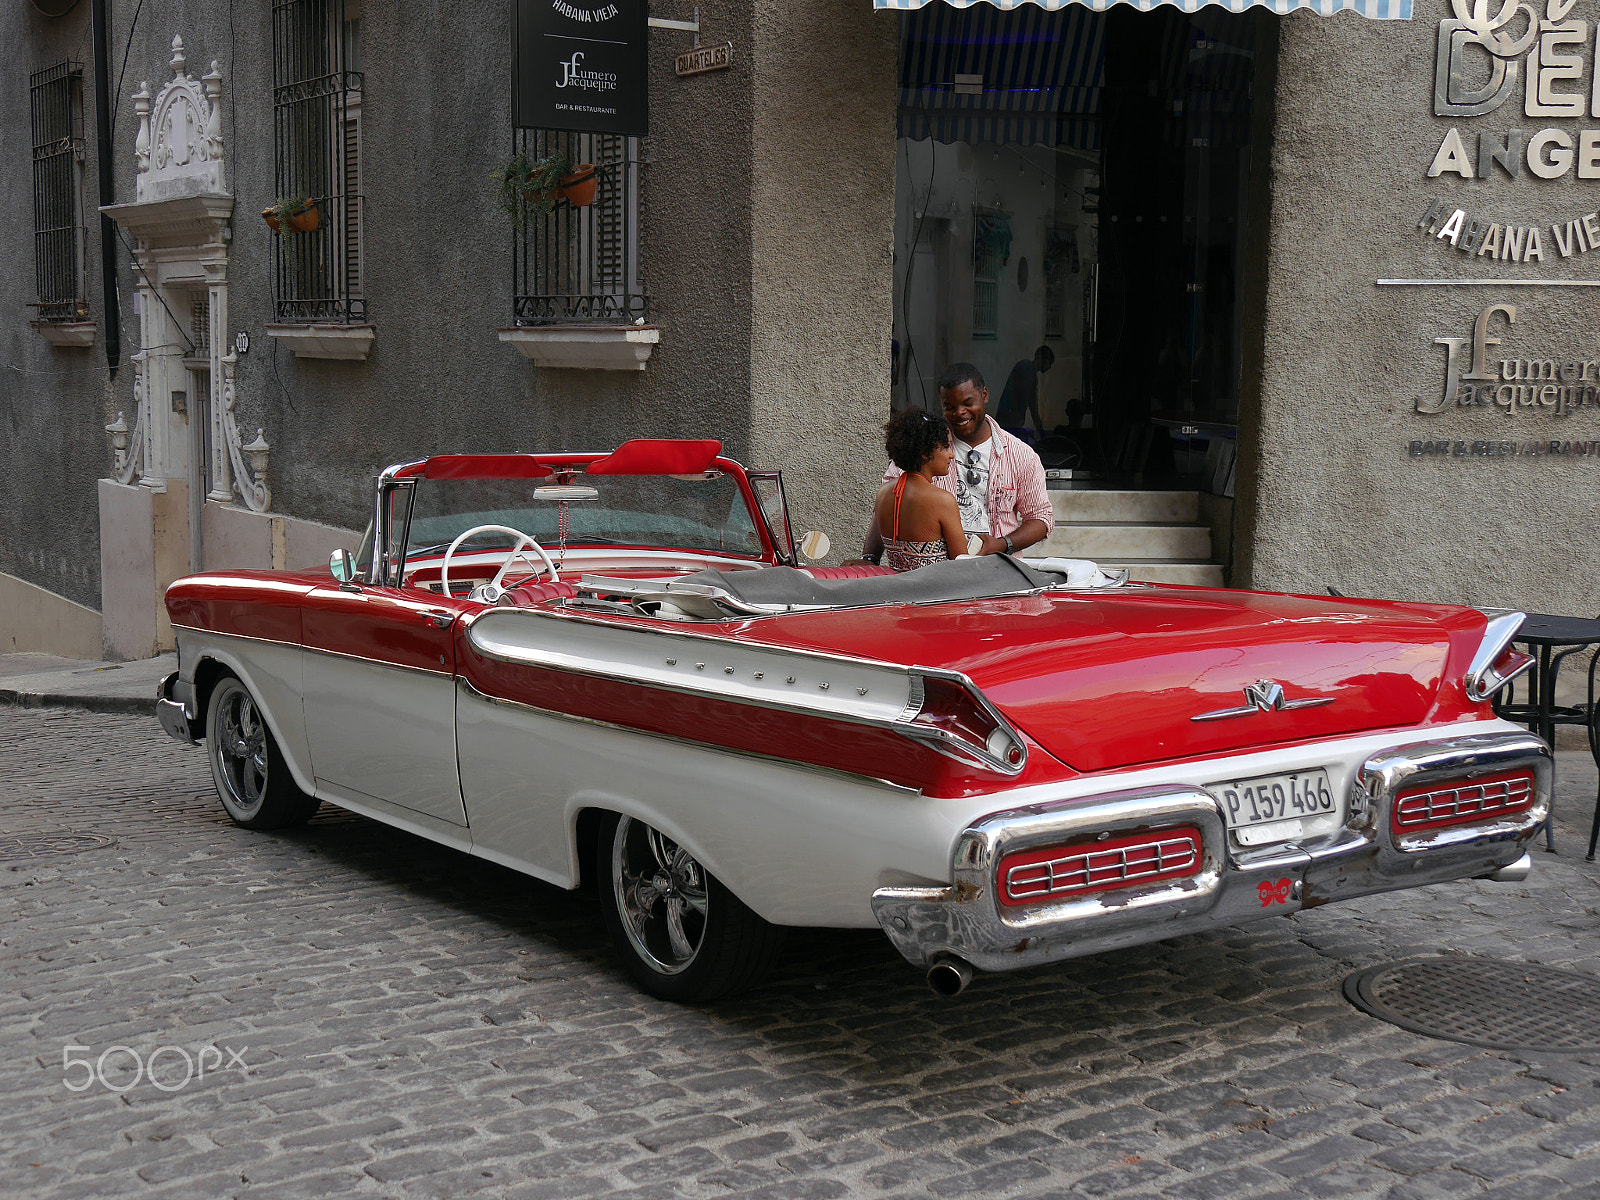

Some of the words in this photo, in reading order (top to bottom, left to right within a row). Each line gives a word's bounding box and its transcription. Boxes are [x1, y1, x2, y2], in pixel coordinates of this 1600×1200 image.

[552, 0, 592, 23] HABANA
[592, 3, 619, 23] VIEJA
[678, 47, 728, 72] CUARTELES
[1434, 19, 1600, 118] DE
[555, 103, 568, 111] BAR
[575, 104, 617, 115] RESTAURANTE
[1418, 199, 1545, 262] HABANA
[1410, 440, 1450, 456] BAR
[1454, 440, 1468, 456] &
[1290, 776, 1331, 814] 466
